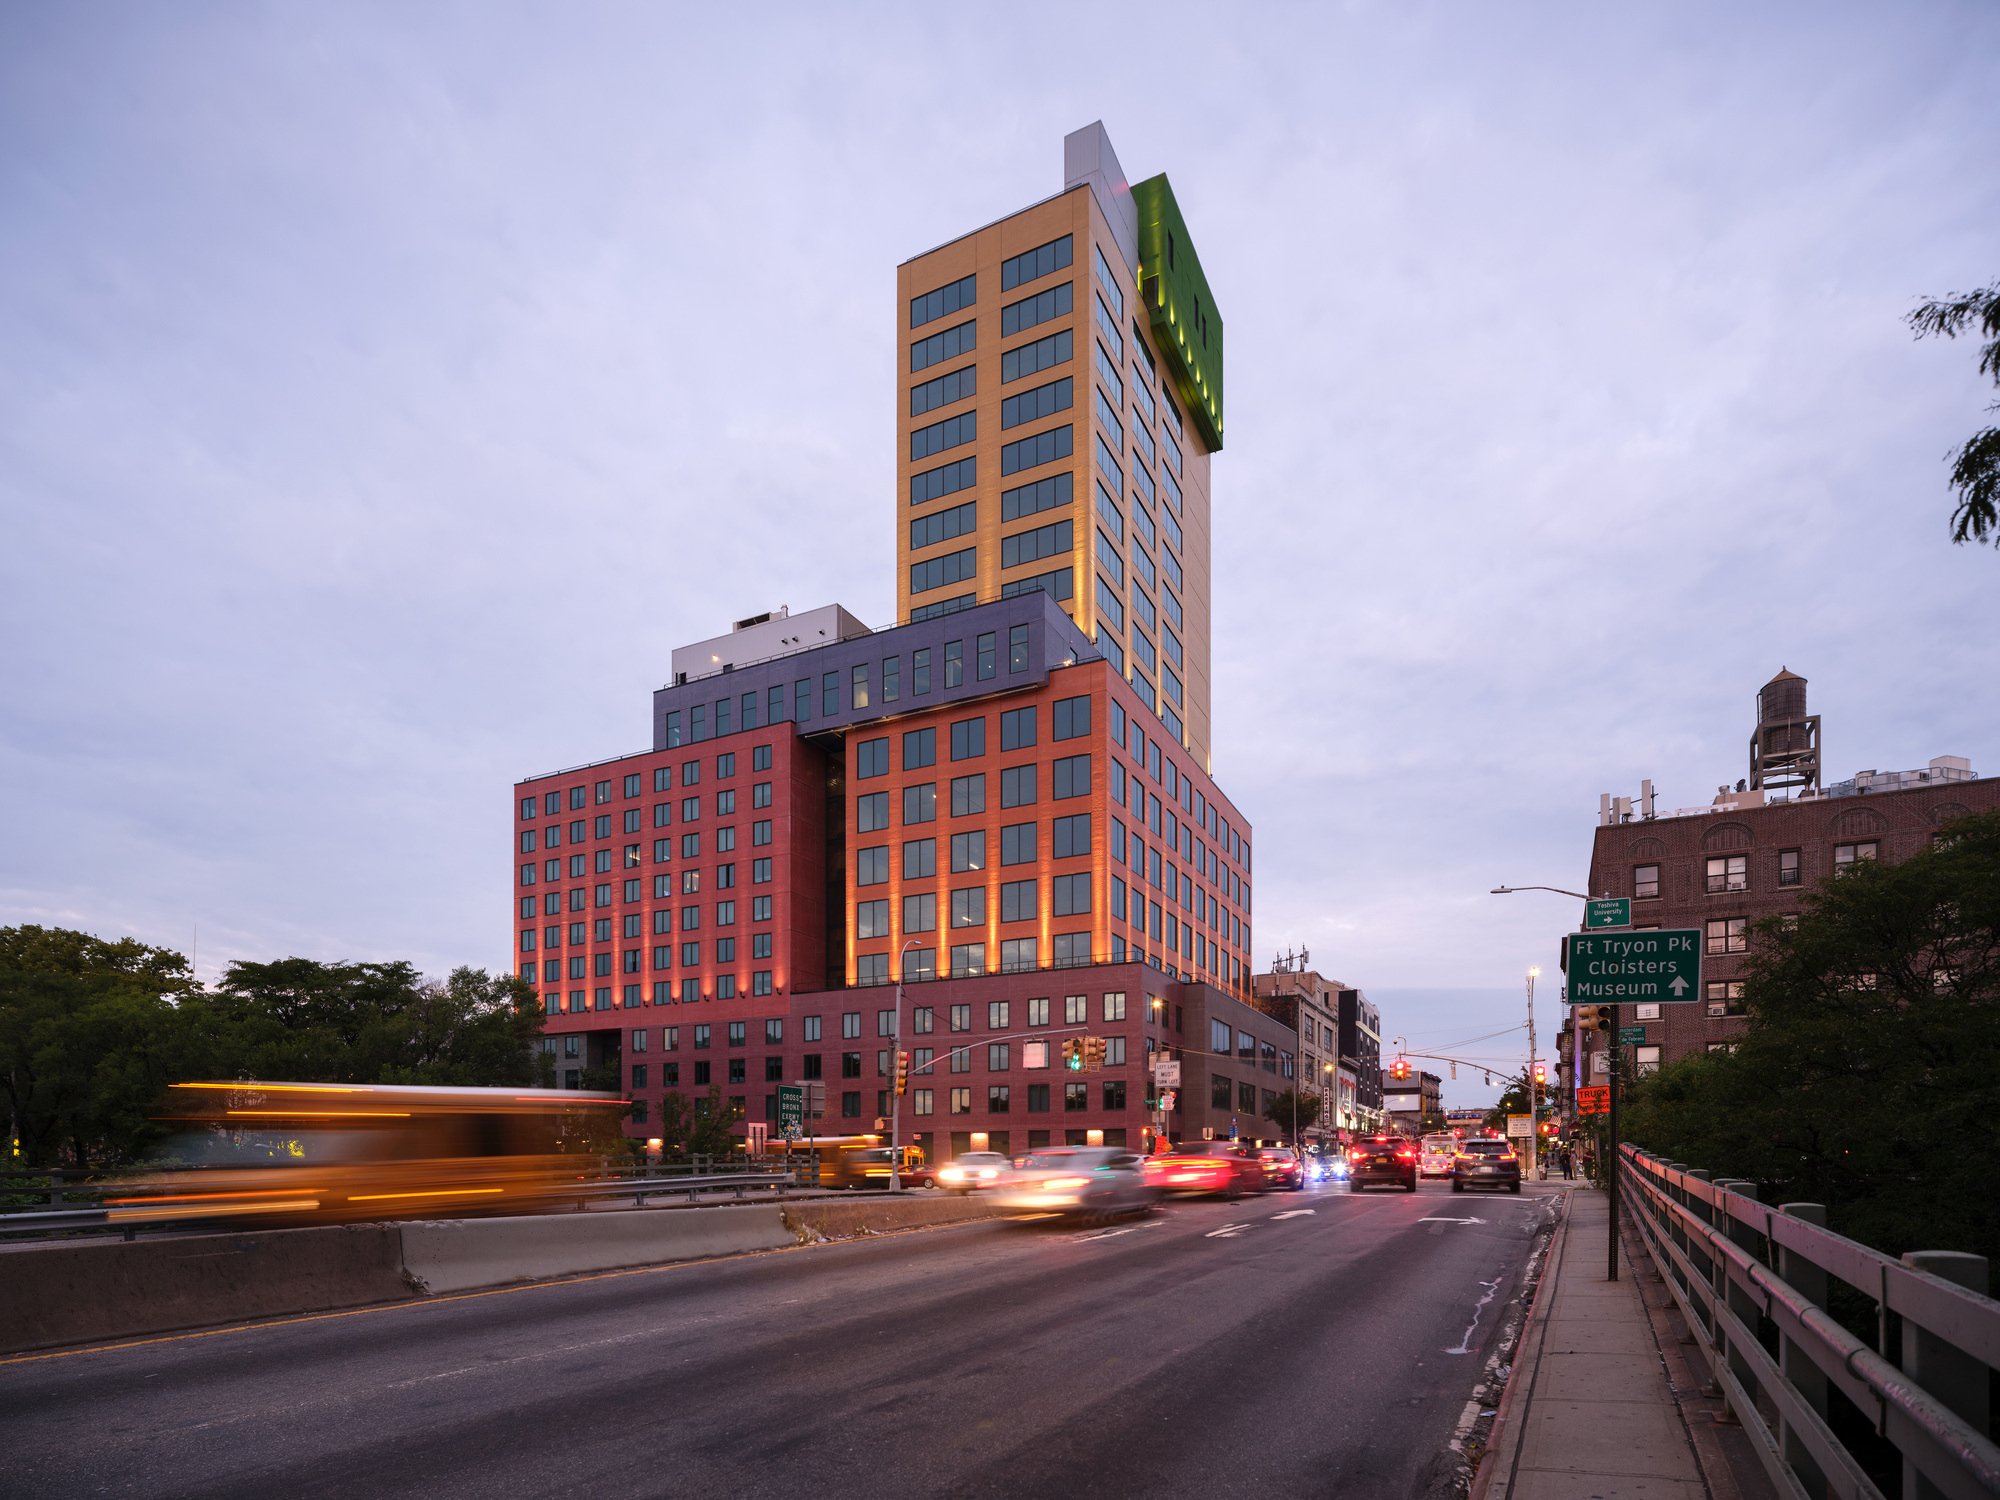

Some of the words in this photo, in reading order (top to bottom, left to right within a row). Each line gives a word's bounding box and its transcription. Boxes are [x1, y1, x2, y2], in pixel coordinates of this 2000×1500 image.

[1594, 908, 1622, 916] University
[1576, 940, 1593, 955] Ft
[1603, 940, 1657, 957] Tryon
[1668, 936, 1692, 952] Pk
[1588, 960, 1677, 975] Cloisters
[1577, 982, 1657, 996] Museum
[782, 1093, 799, 1101] CROSS
[1579, 1088, 1608, 1099] TRUCK
[782, 1103, 800, 1111] BRONX
